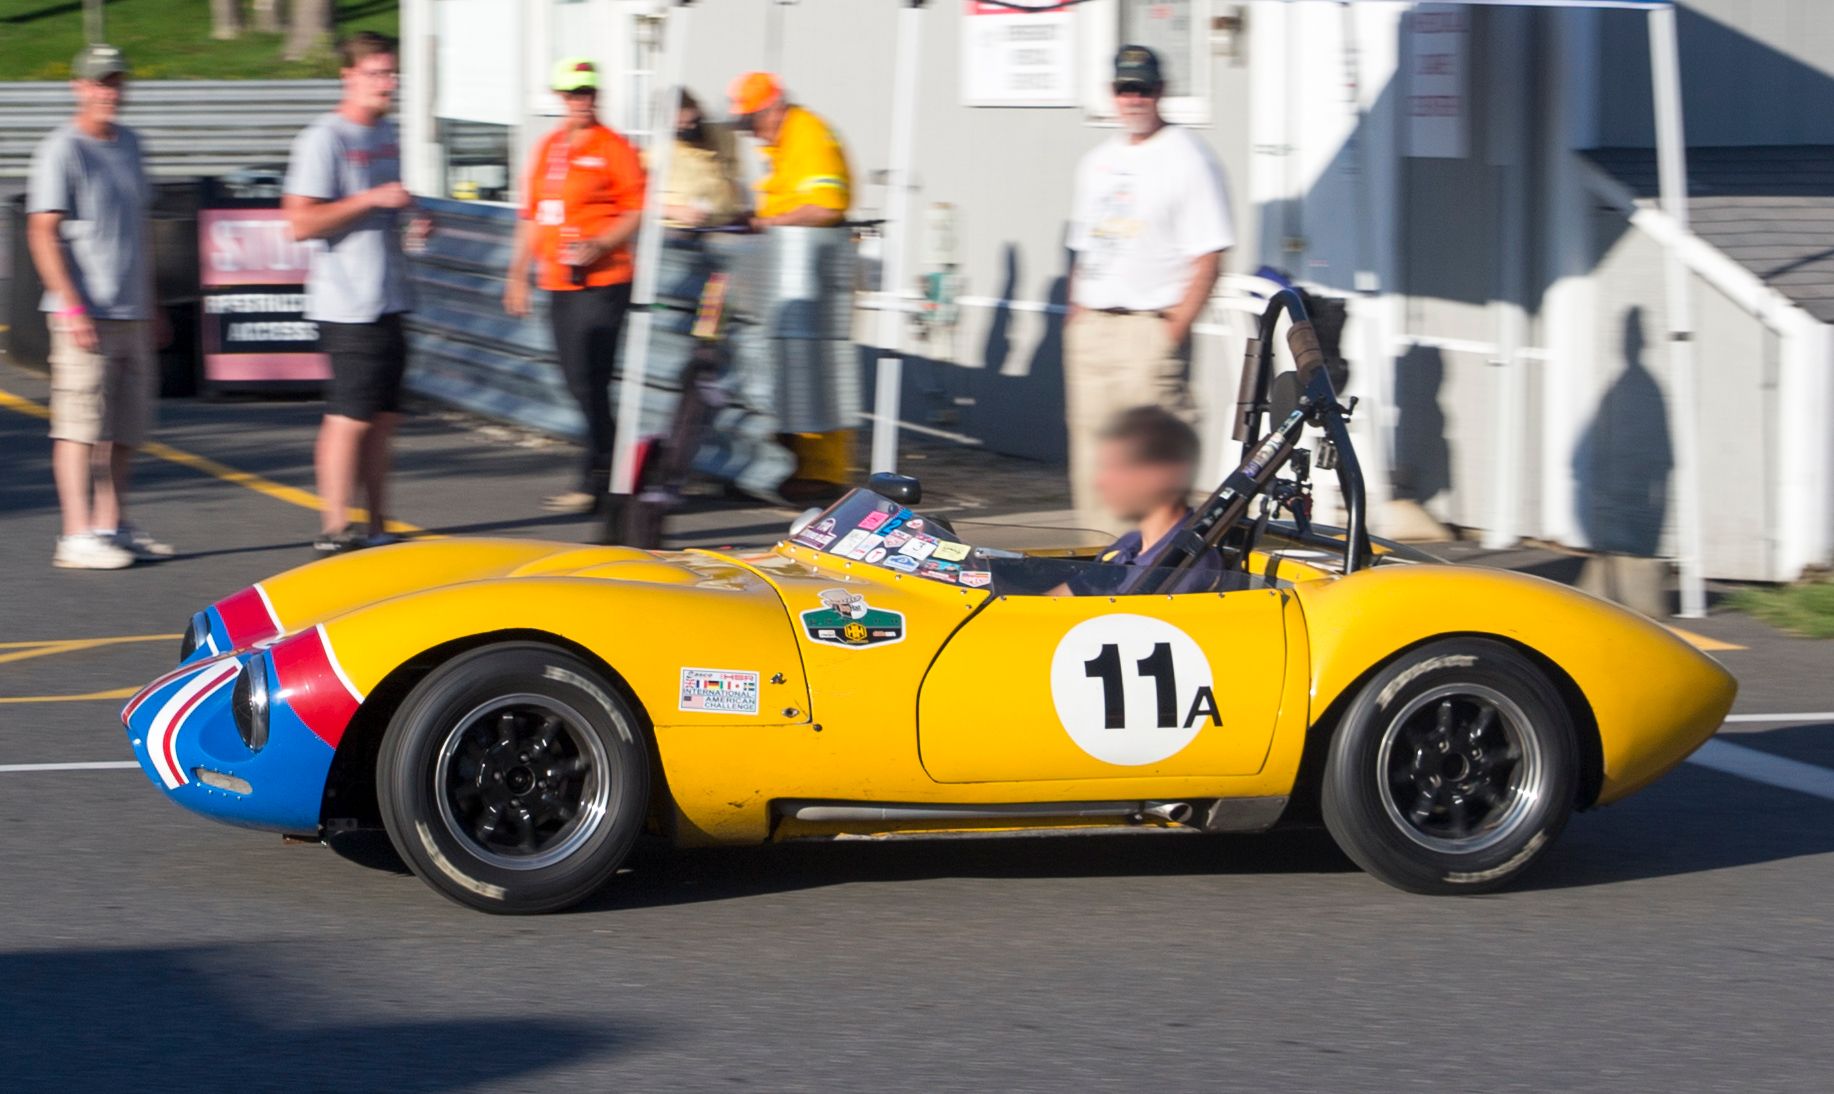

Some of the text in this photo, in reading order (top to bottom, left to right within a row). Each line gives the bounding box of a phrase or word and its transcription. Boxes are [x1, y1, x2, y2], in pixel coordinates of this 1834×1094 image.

[682, 688, 752, 698] INTERNATIONAL
[705, 696, 755, 704] AMERICAN
[704, 702, 754, 710] CHALLENGE
